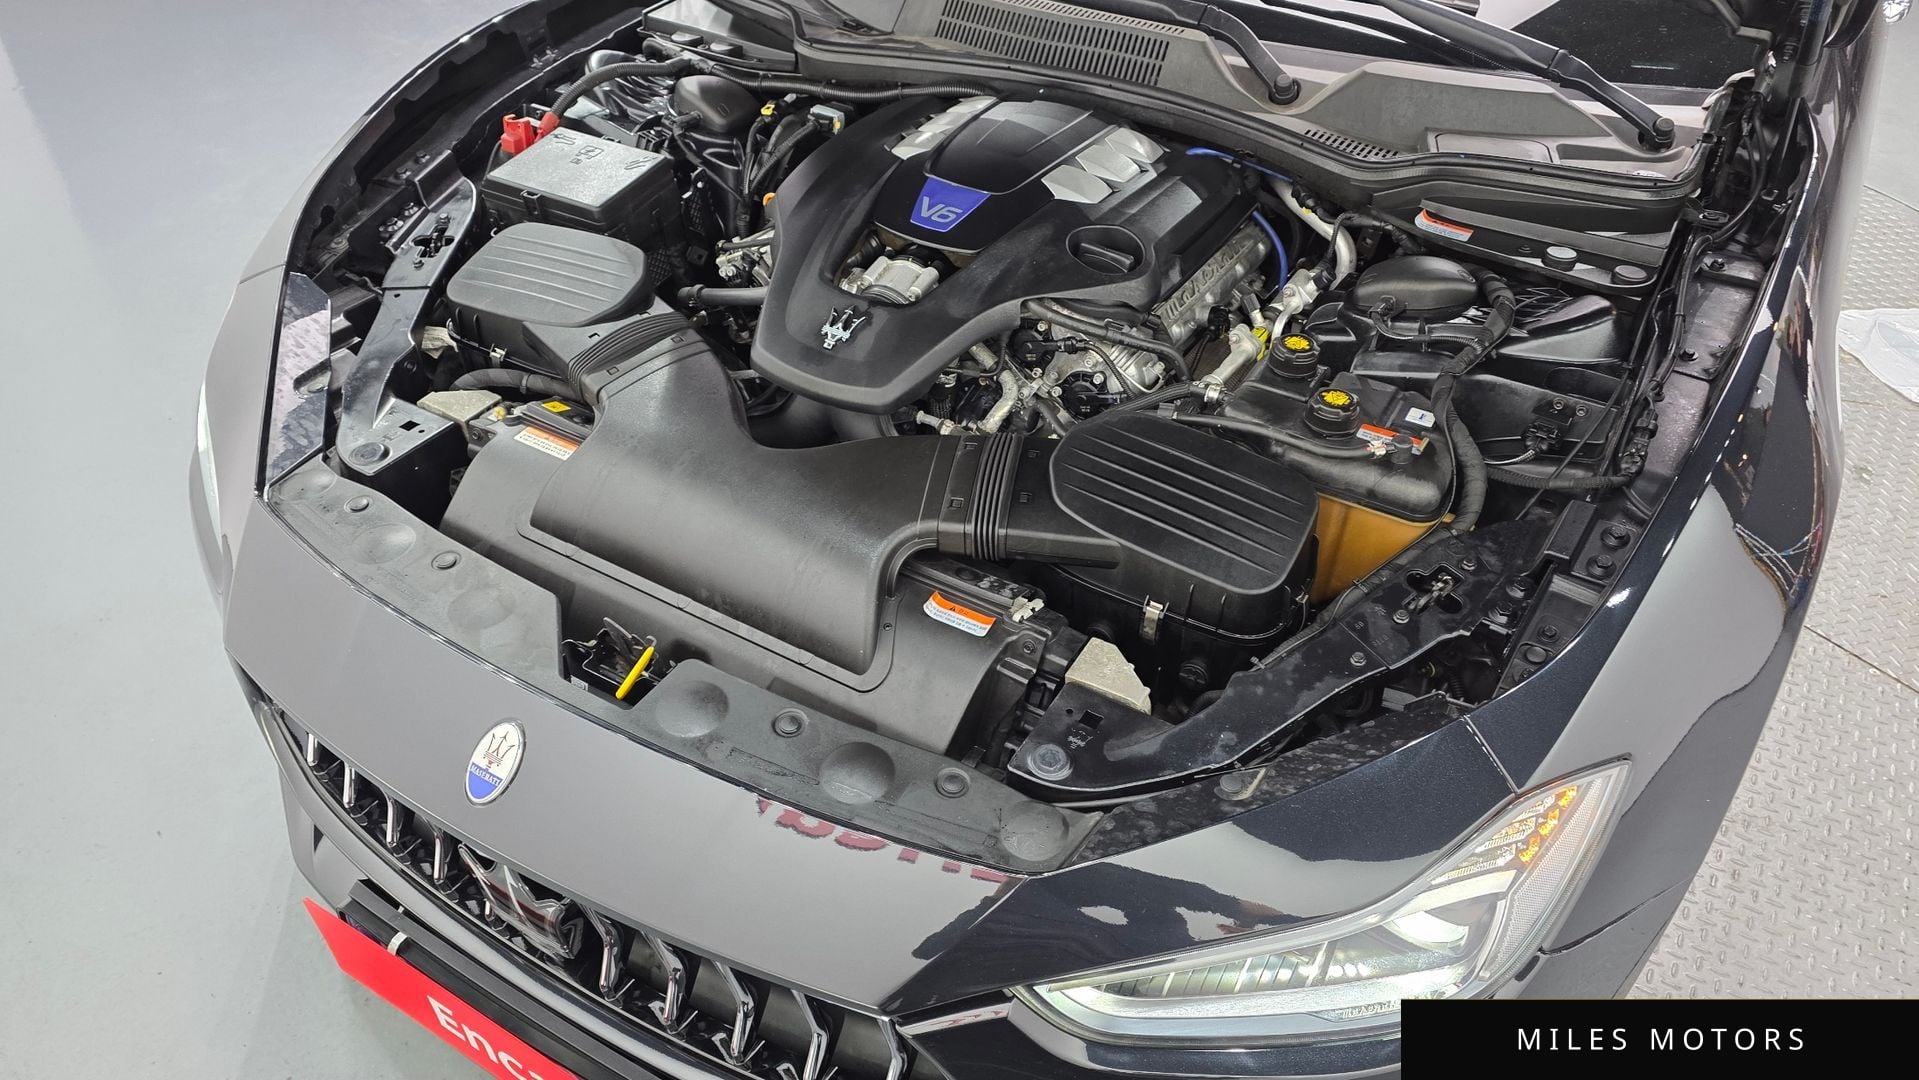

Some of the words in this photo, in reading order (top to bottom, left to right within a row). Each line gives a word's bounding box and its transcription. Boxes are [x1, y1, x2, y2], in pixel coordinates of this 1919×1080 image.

[921, 196, 963, 223] V6
[471, 764, 501, 787] MASERATI
[426, 995, 545, 1080] Enc
